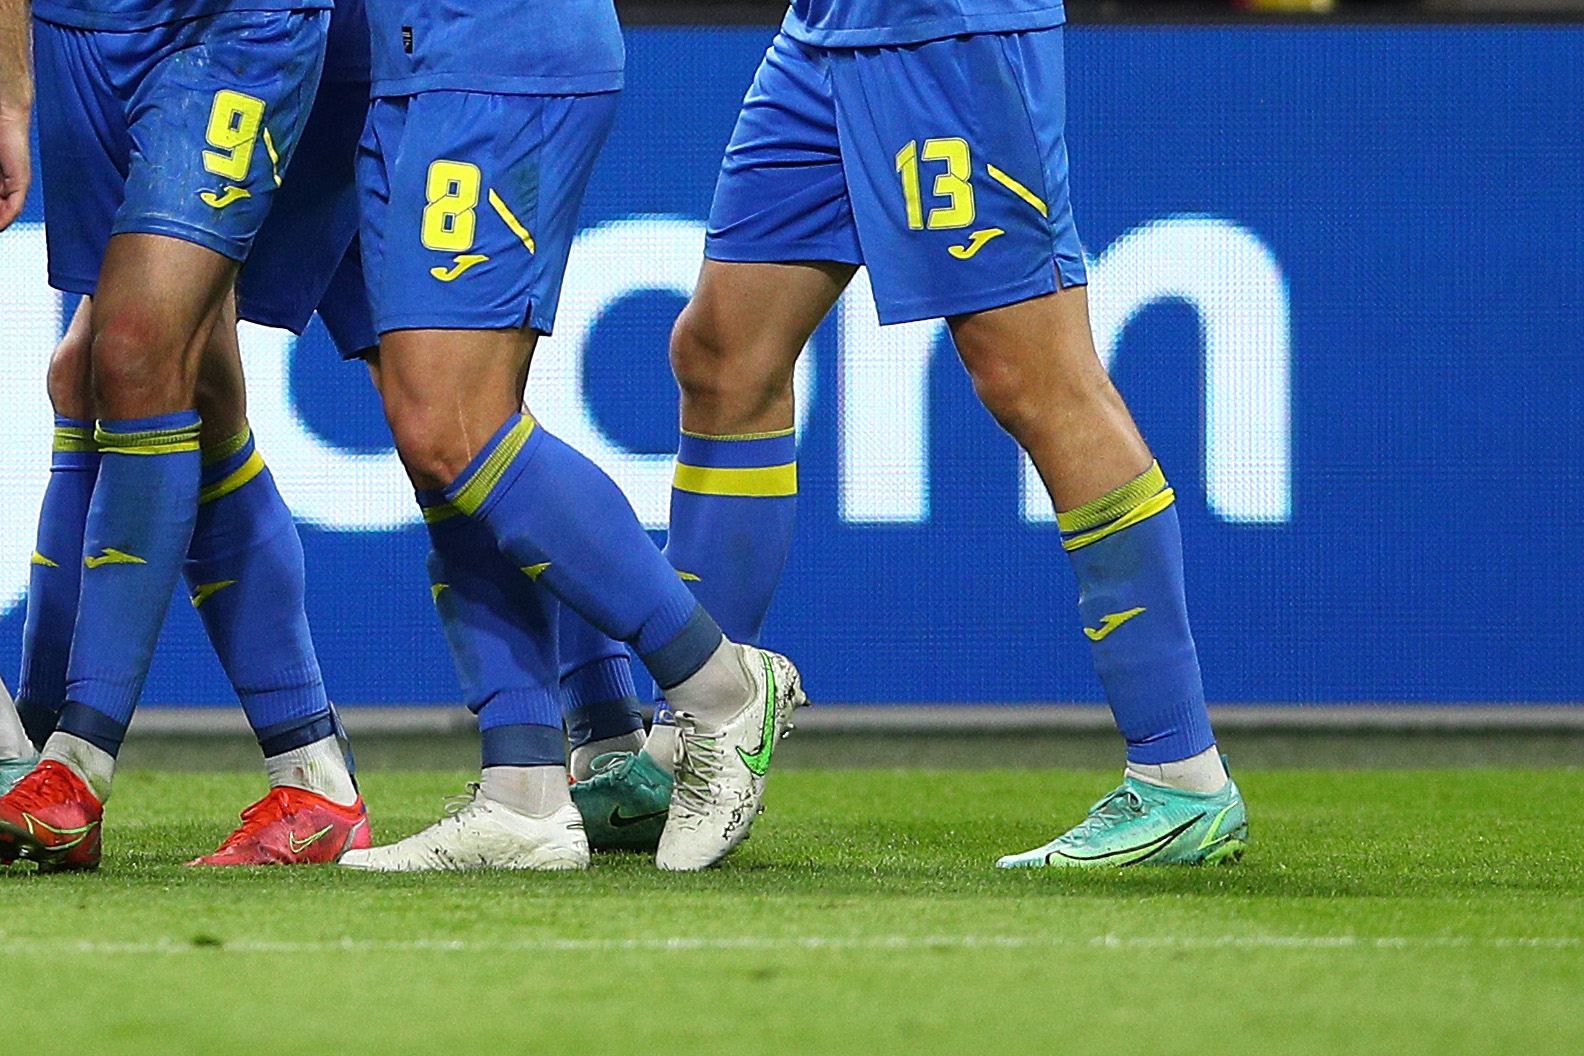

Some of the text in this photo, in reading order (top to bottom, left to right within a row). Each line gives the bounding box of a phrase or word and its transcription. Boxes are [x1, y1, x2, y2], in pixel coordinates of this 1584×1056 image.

[201, 89, 266, 182] 9
[421, 159, 481, 252] 8
[896, 136, 975, 230] 13
